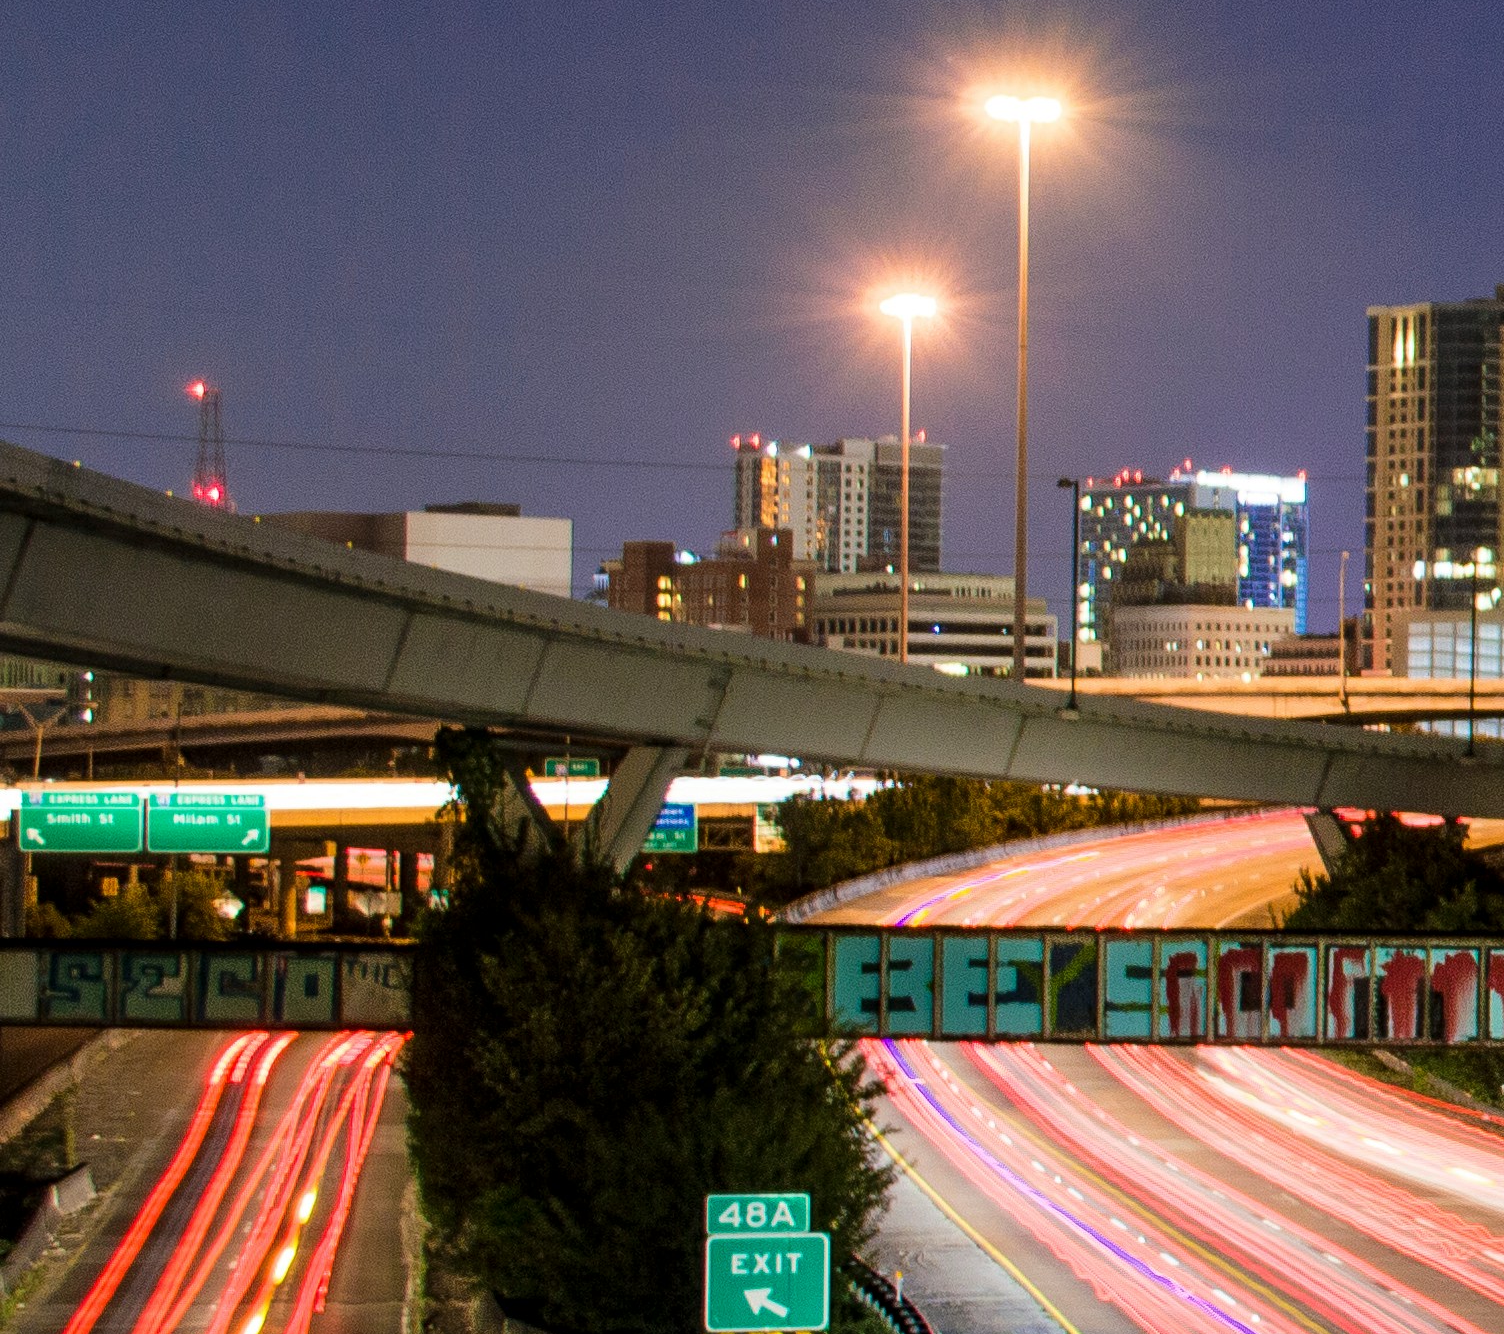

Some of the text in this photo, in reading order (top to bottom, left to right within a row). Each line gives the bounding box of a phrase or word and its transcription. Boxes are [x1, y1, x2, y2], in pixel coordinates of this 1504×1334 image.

[49, 794, 99, 805] EXPRESS
[104, 794, 133, 805] LANE
[177, 795, 226, 806] EXPRESS
[231, 795, 260, 806] LANE
[46, 813, 115, 825] Smith St
[173, 813, 242, 826] Milam St
[718, 1200, 796, 1228] 48A
[731, 1252, 803, 1275] EXIT
